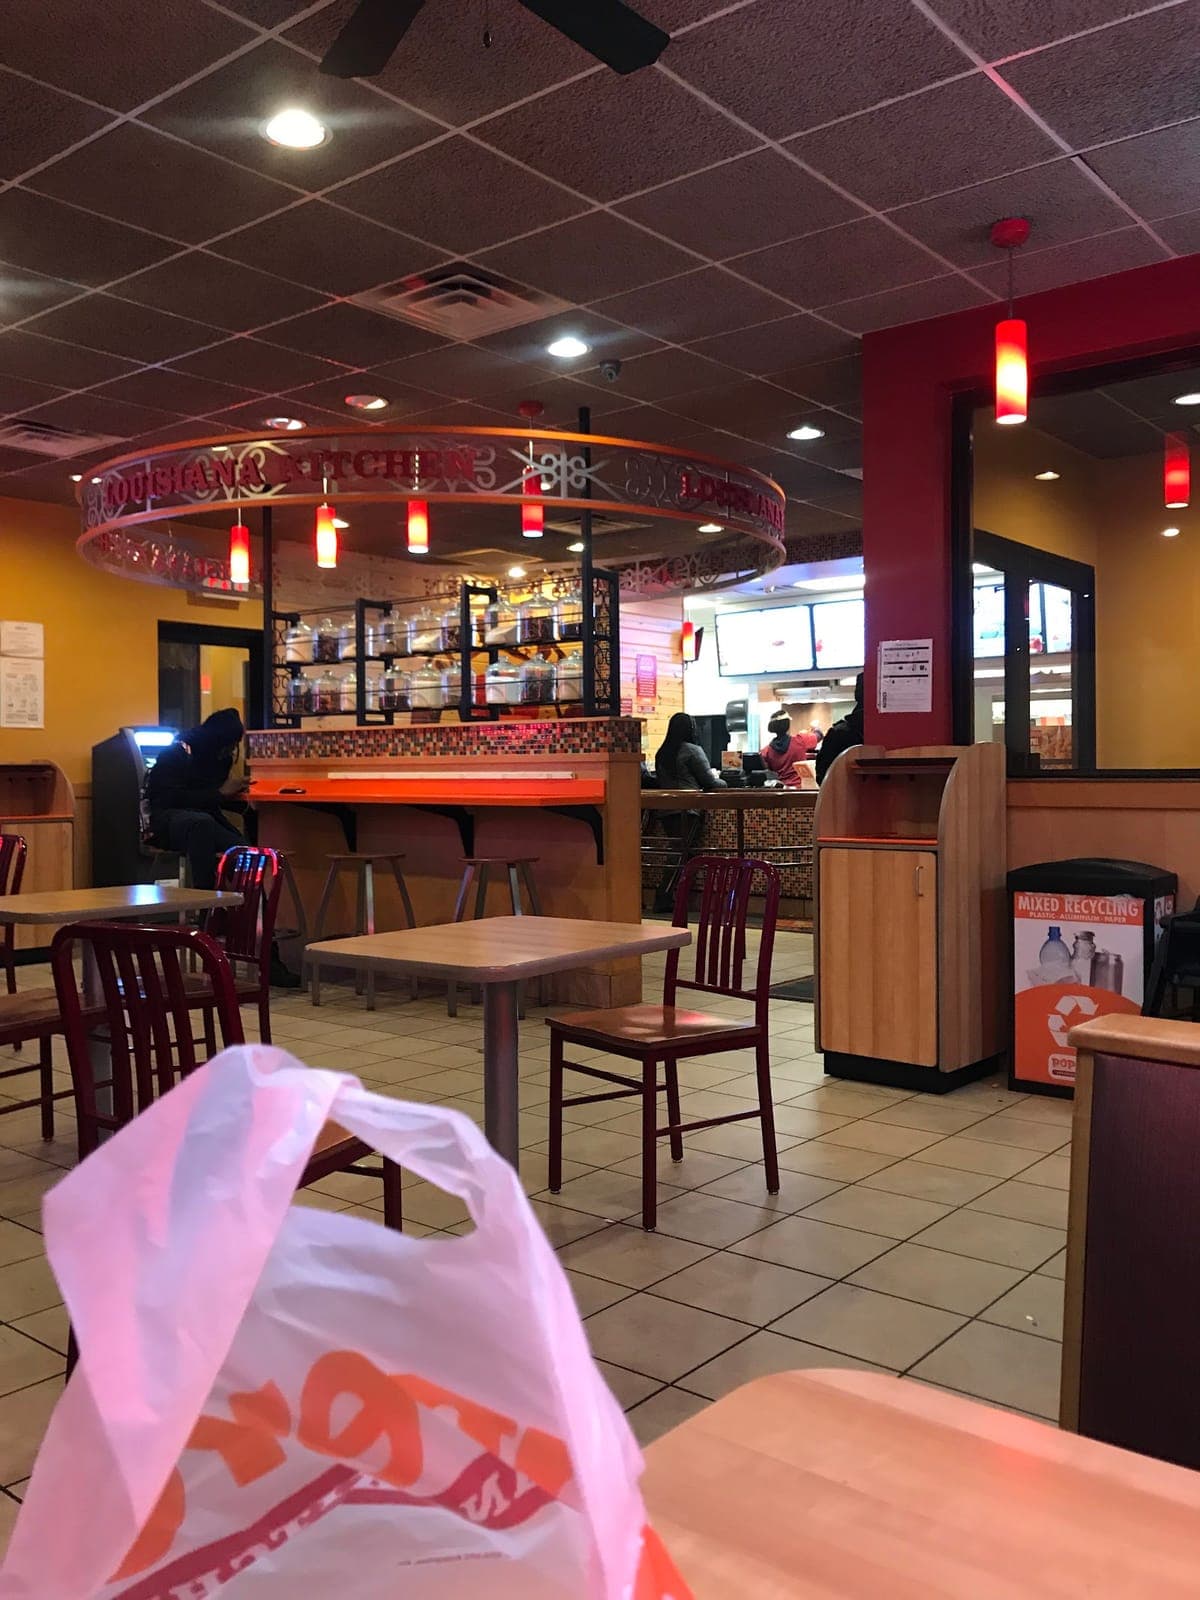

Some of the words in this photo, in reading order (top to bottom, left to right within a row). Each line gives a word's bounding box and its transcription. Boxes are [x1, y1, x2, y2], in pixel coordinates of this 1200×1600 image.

[105, 457, 264, 508] LOUISIANA
[280, 448, 476, 483] KITCHEN
[1018, 895, 1060, 912] MIXED
[1064, 897, 1139, 917] RECYCLING
[1029, 911, 1056, 920] PLASTIC
